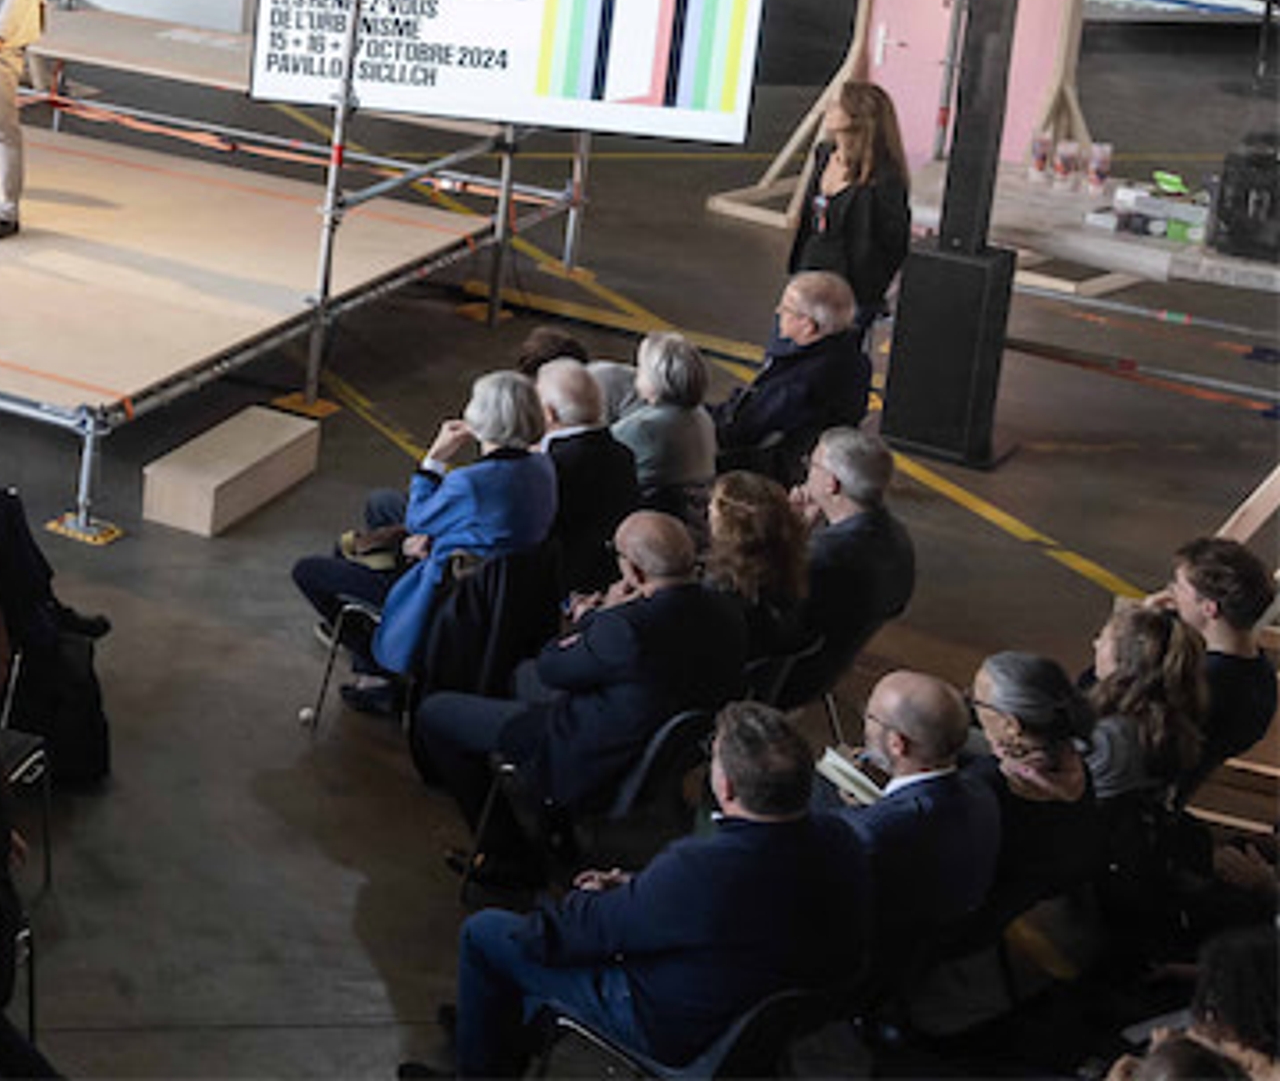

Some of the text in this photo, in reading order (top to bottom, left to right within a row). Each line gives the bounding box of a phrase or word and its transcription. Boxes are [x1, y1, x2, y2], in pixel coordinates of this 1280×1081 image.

[269, 8, 421, 41] DE L'URBNISME
[266, 53, 344, 78] PAVILLO
[269, 31, 287, 51] 15
[366, 39, 453, 65] OCTOBRE
[457, 45, 508, 70] 2024
